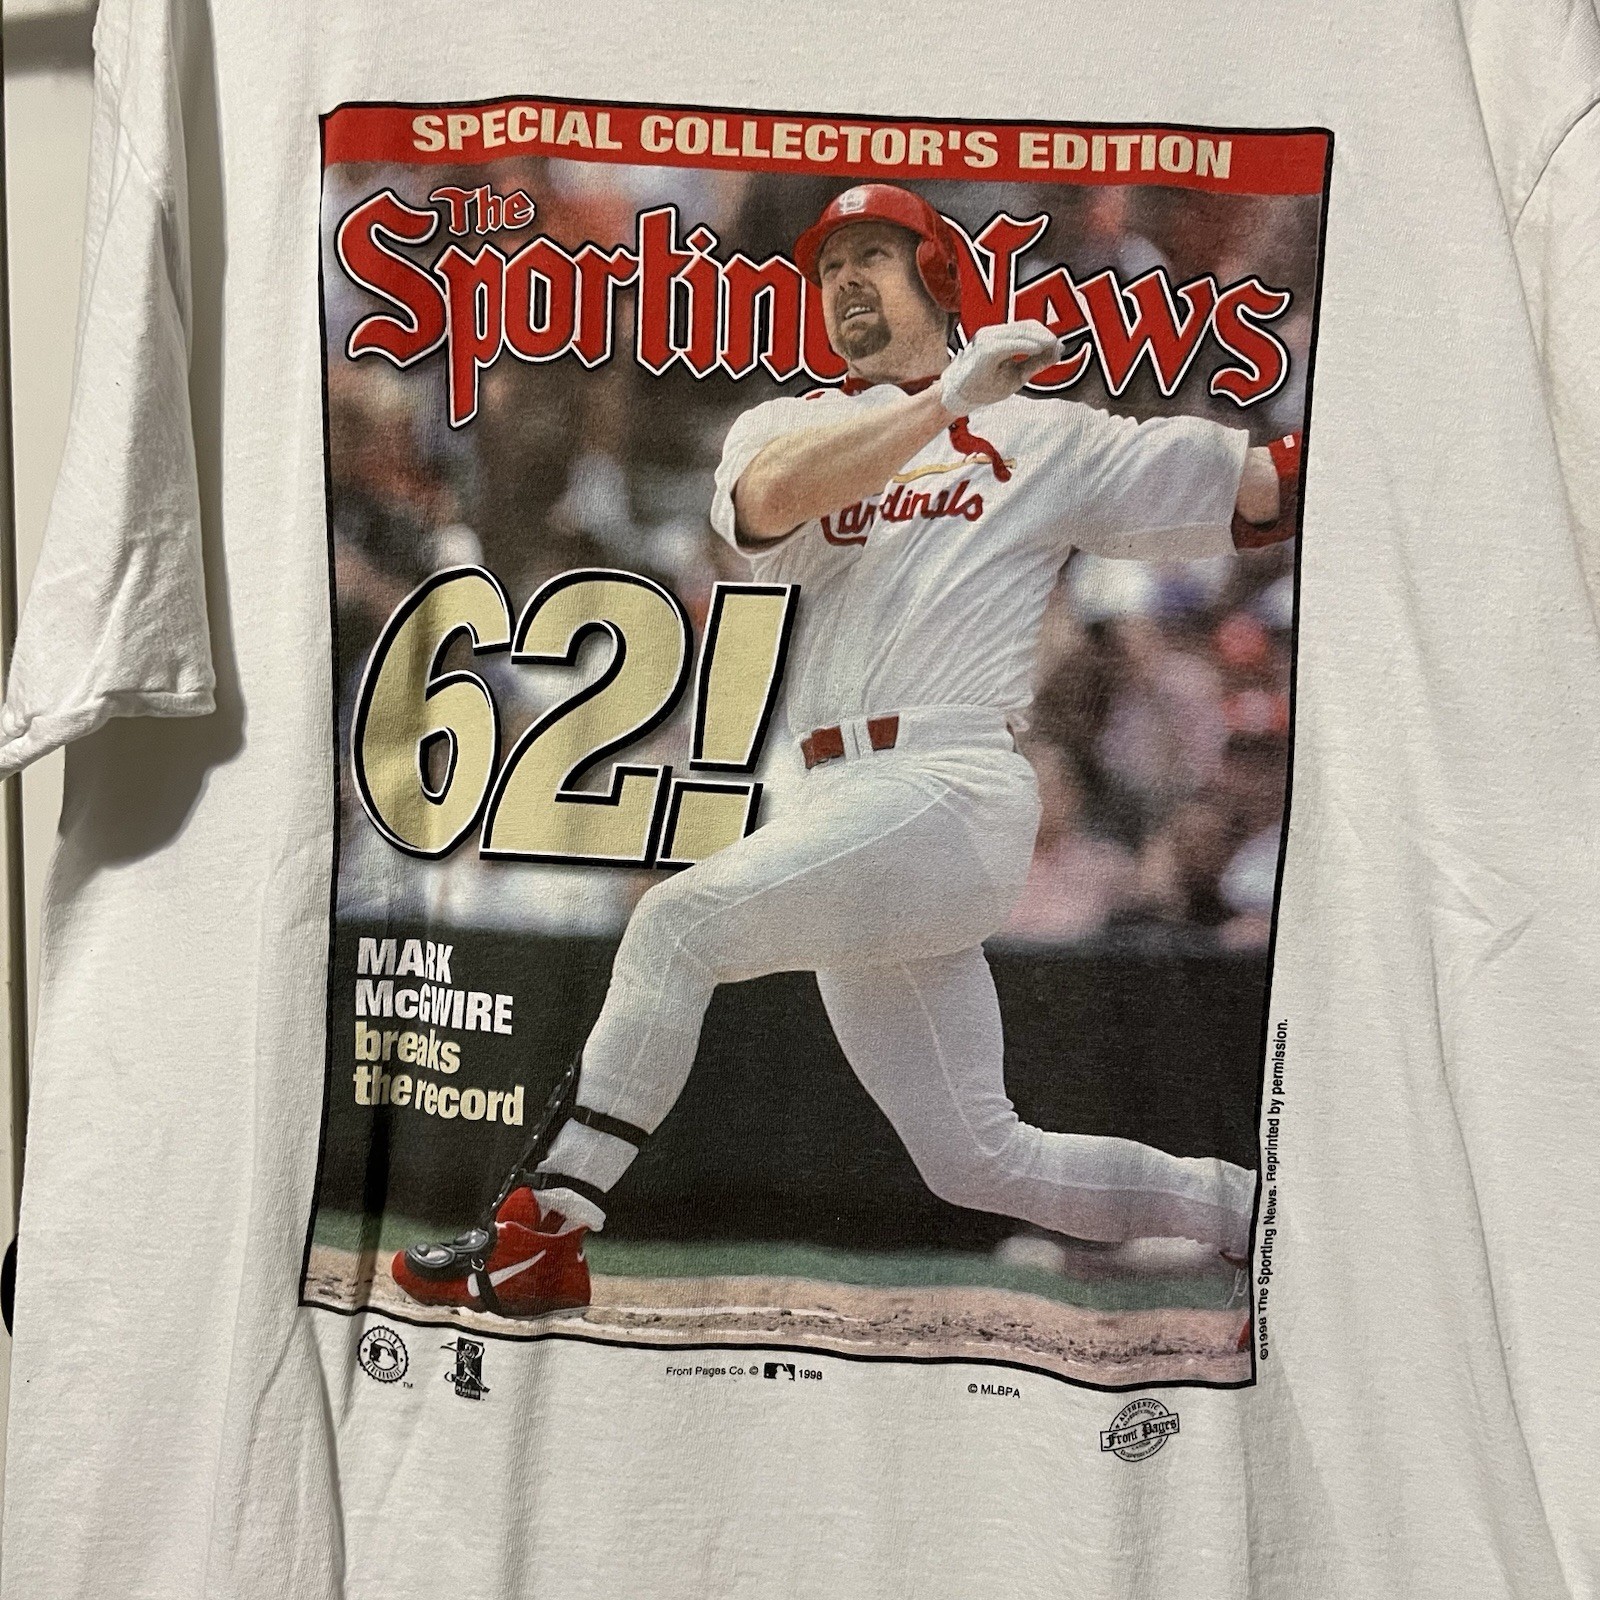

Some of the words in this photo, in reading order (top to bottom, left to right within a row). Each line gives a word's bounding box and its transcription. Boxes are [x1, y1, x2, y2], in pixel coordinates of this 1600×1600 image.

[412, 107, 623, 152] SPECIAL
[640, 115, 999, 168] COLLECTOR'S
[1018, 132, 1232, 179] EDITION
[430, 185, 535, 236] The
[941, 211, 1291, 409] News
[351, 564, 801, 870] 62!
[357, 937, 454, 984] MARK
[355, 978, 513, 1035] McGWIRE
[355, 1020, 461, 1074] breaks
[1271, 1019, 1288, 1095] permission.
[353, 1065, 412, 1106] the
[414, 1079, 525, 1126] record
[1267, 1099, 1285, 1114] by
[1264, 1118, 1280, 1181] Reprinted
[1263, 1185, 1277, 1225] News.
[1258, 1228, 1277, 1285] Sporting
[1258, 1288, 1269, 1314] The
[666, 1366, 693, 1376] Front
[695, 1366, 726, 1378] Pages
[729, 1366, 746, 1376] Co.
[798, 1369, 823, 1381] 1998
[981, 1384, 1020, 1398] MLBPA
